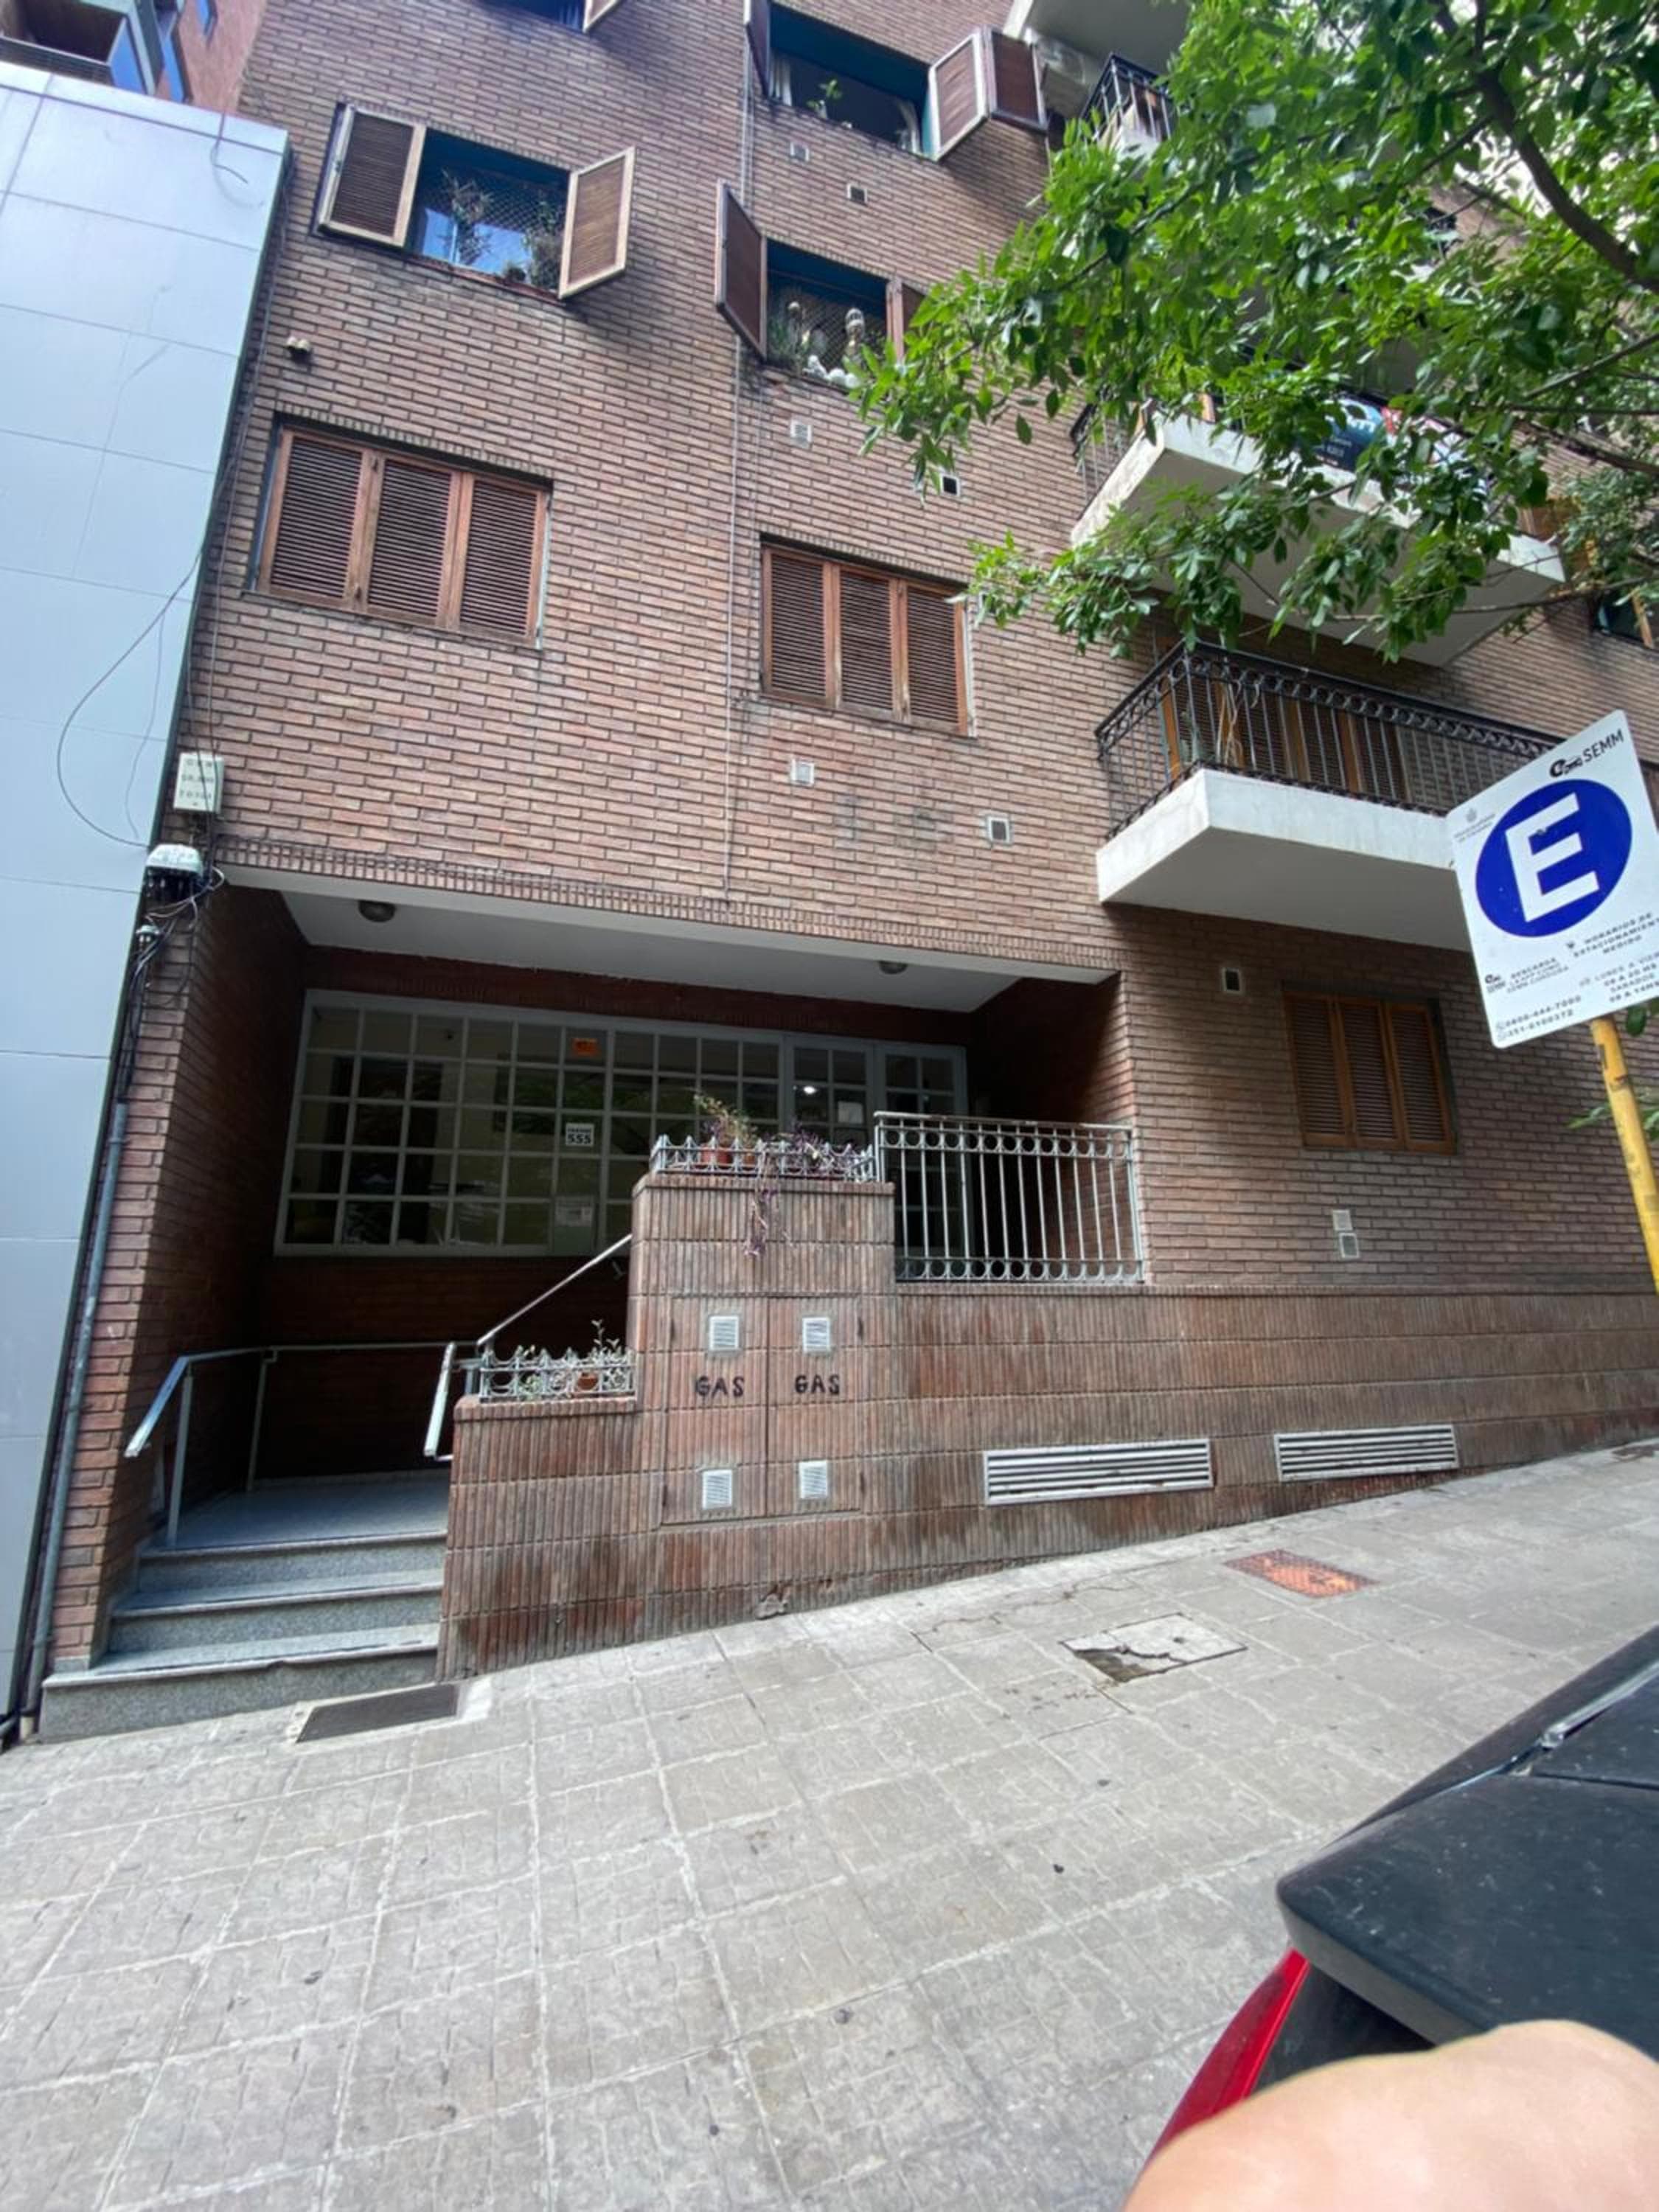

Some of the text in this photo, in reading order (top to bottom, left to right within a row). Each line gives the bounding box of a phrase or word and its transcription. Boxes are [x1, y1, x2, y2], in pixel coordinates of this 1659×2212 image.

[1582, 727, 1624, 762] SEMM
[1505, 793, 1599, 923] E
[1585, 918, 1635, 944] HORARIOS
[695, 1376, 745, 1399] GAS
[795, 1374, 841, 1396] GAS
